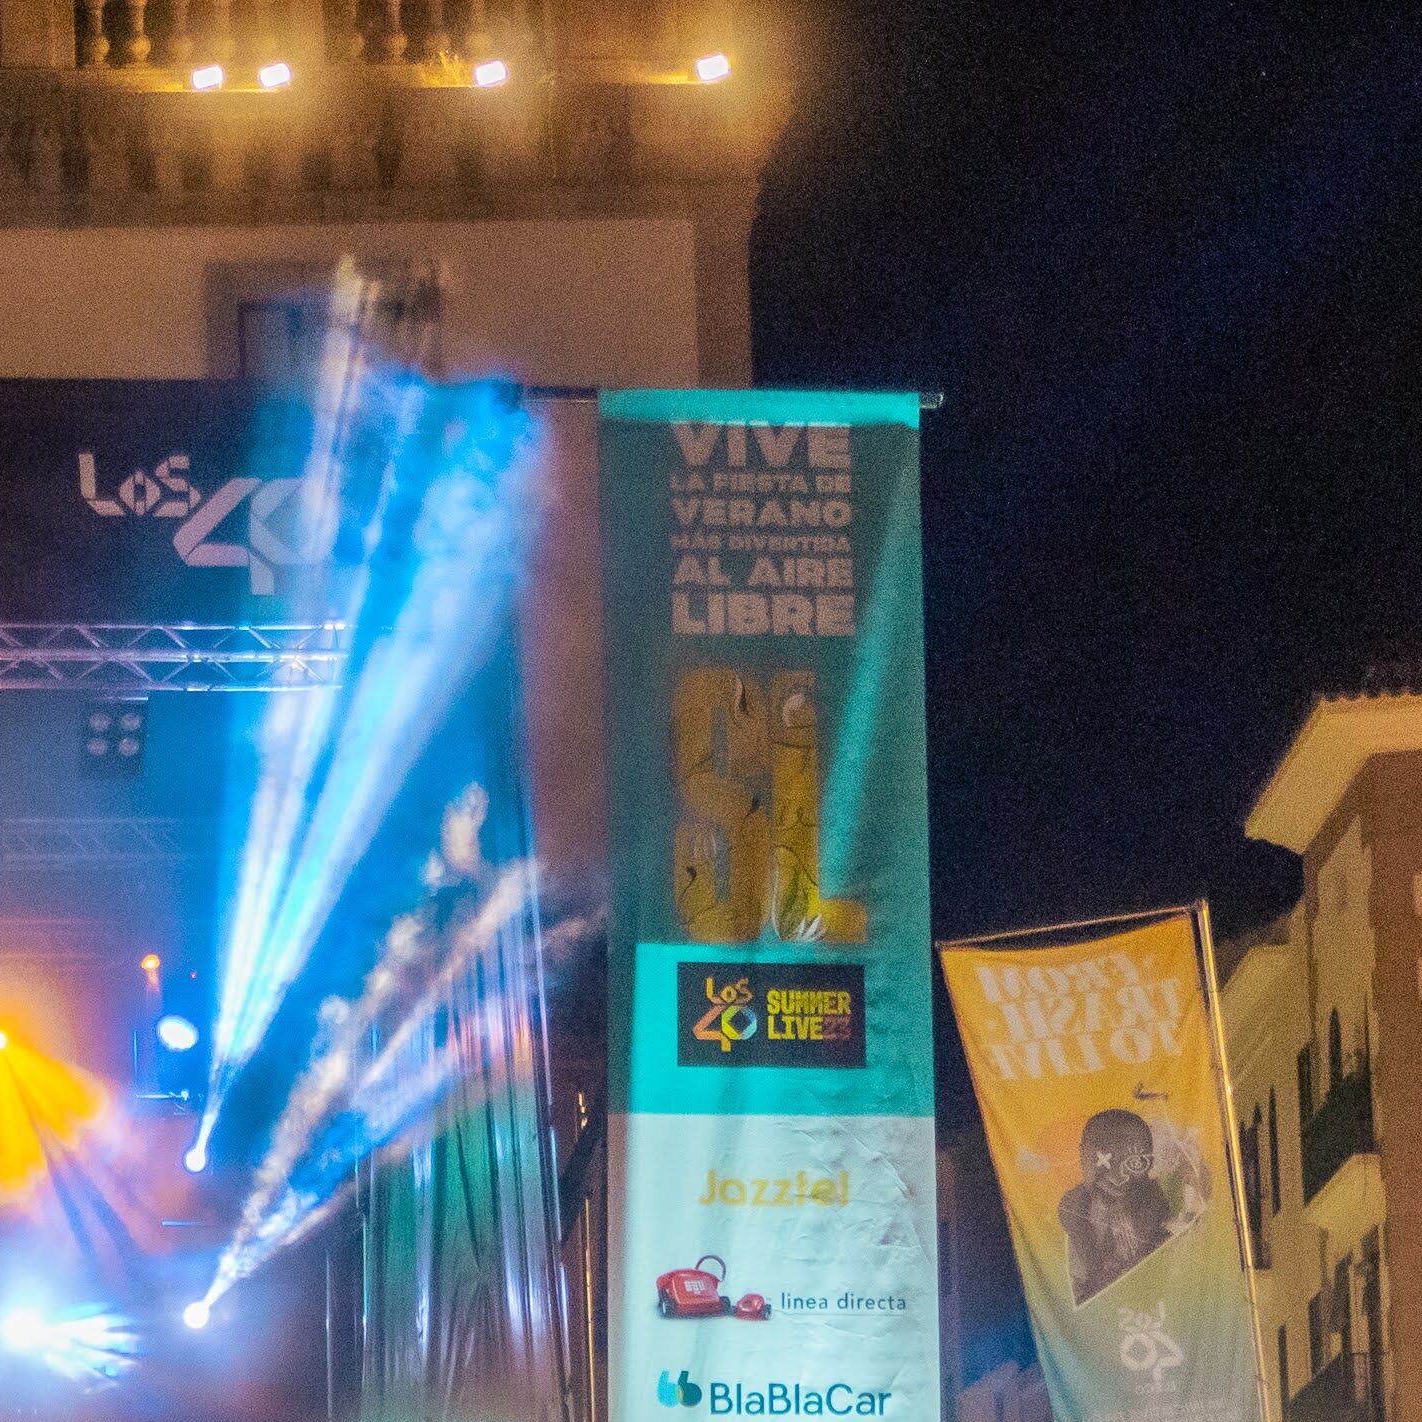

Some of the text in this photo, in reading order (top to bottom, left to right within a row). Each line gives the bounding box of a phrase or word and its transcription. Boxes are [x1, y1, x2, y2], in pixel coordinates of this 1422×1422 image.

[670, 420, 852, 468] VIVE
[669, 474, 706, 492] LA
[670, 498, 854, 528] VERANO
[173, 477, 339, 596] 40
[672, 554, 855, 588] AL AIRE
[670, 592, 856, 637] LIBRE
[766, 988, 852, 1015] SUMMER
[692, 1003, 758, 1053] 40
[837, 1292, 907, 1311] directa
[710, 1382, 893, 1417] BlaBlaCar
